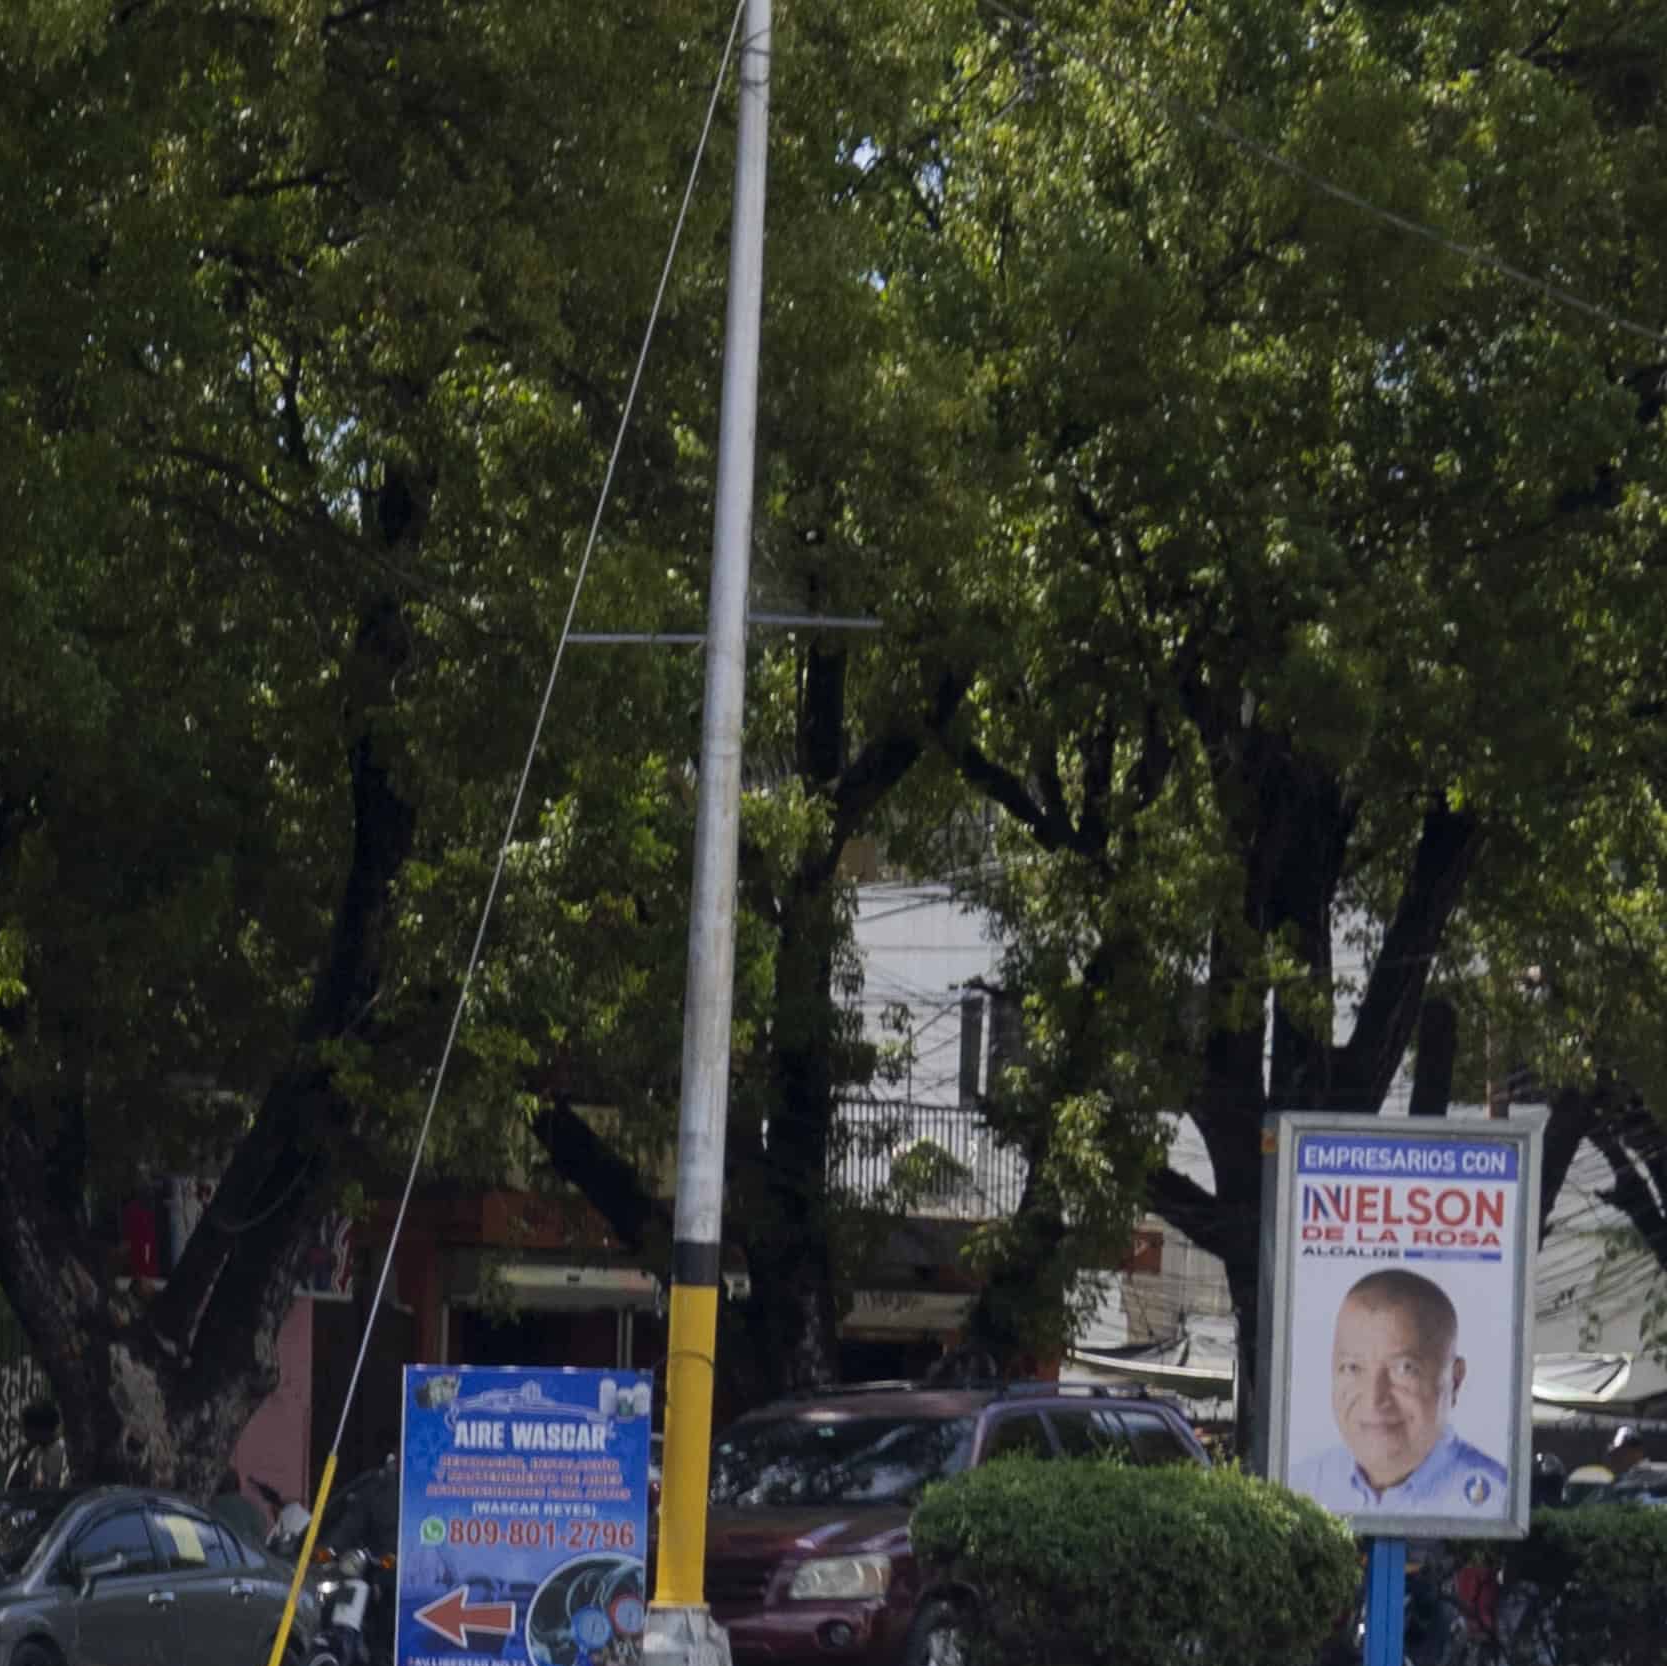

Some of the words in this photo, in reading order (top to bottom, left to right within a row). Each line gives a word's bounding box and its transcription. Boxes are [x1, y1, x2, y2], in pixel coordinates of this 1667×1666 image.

[1304, 1145, 1456, 1172] EMPRESARIOS
[1461, 1150, 1507, 1174] CON
[1301, 1226, 1344, 1241] DE
[1356, 1228, 1399, 1244] LA
[1412, 1230, 1501, 1246] ROSA
[1301, 1245, 1400, 1259] ALCALDE
[454, 1421, 505, 1449] AIRE
[511, 1422, 607, 1451] WASCAR
[449, 1518, 636, 1549] 809-801-2796
